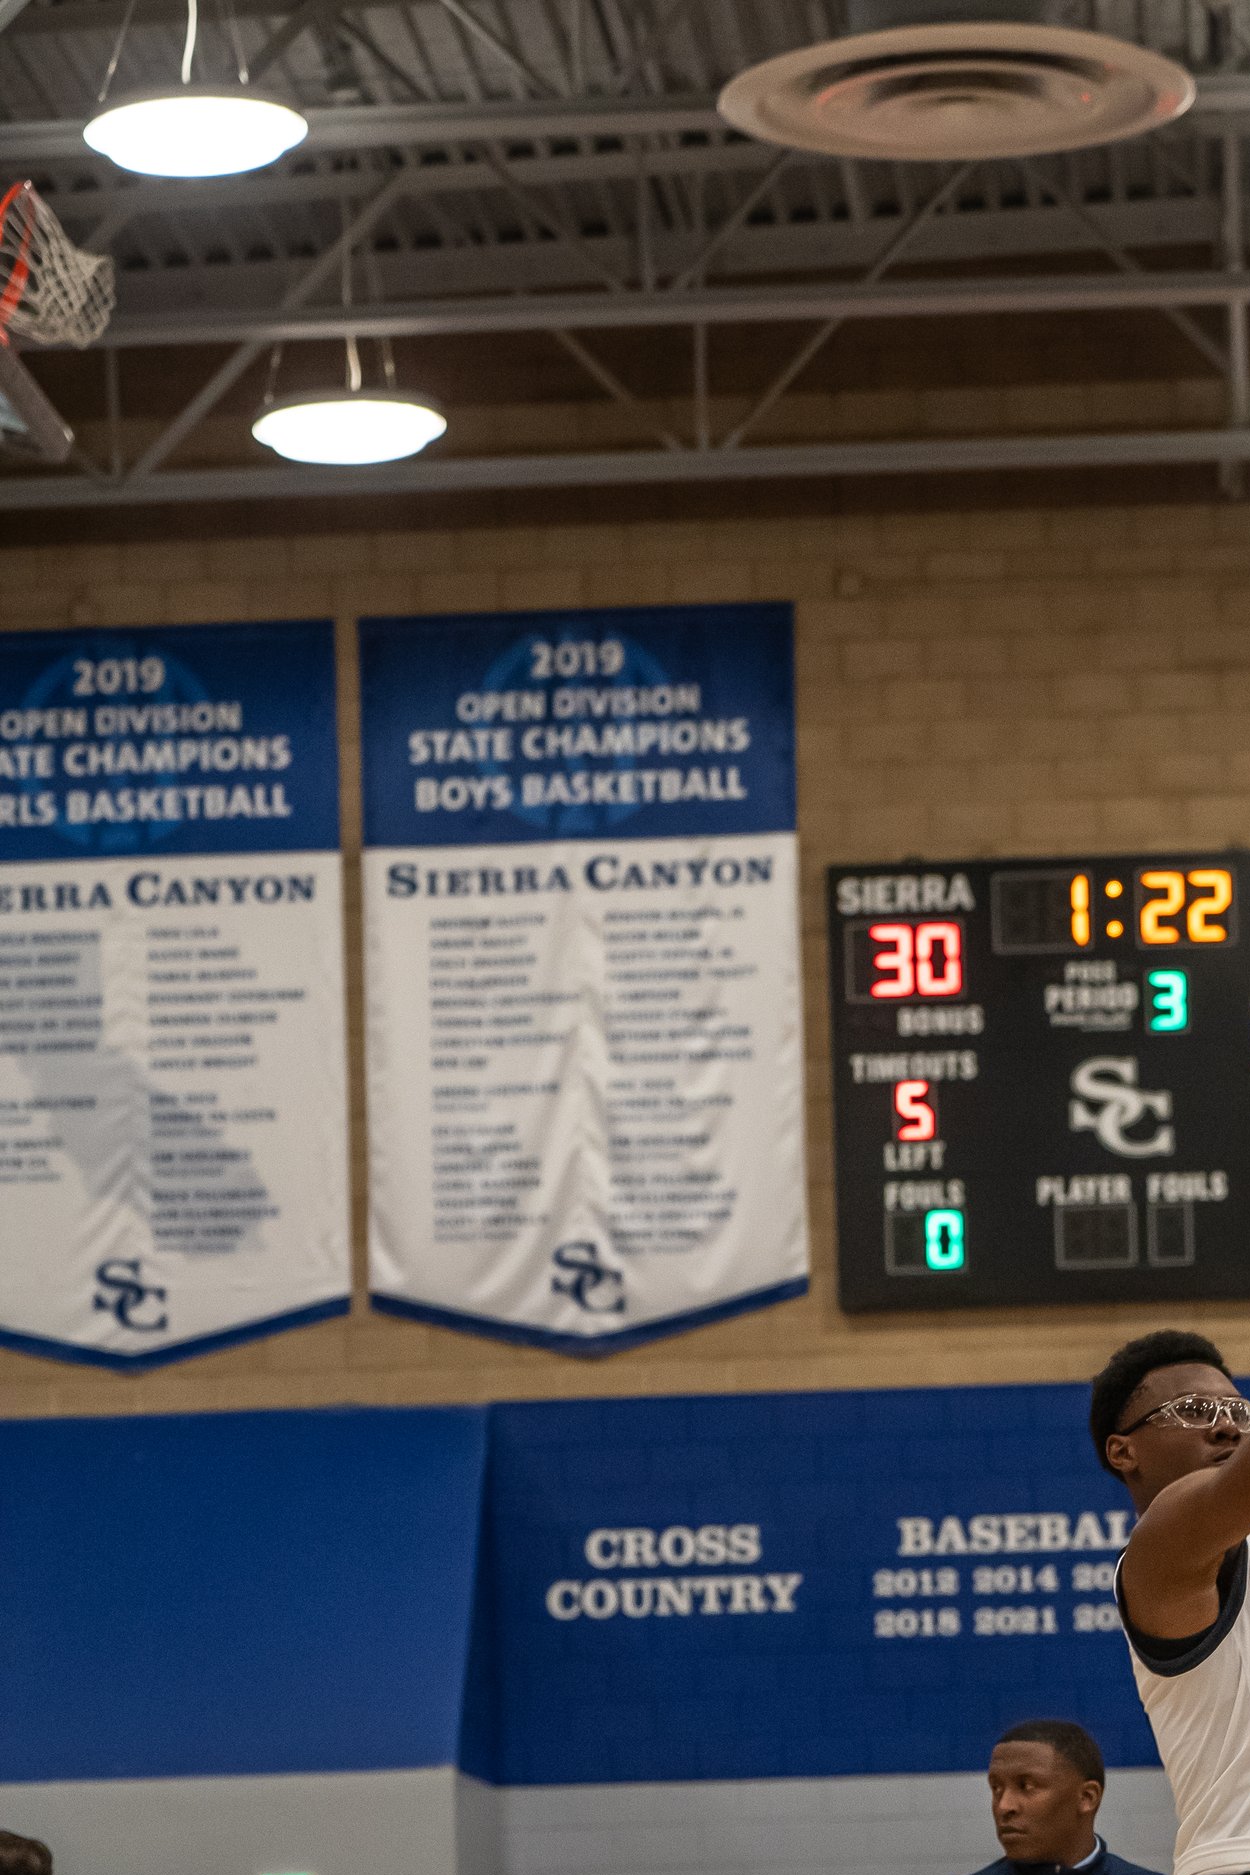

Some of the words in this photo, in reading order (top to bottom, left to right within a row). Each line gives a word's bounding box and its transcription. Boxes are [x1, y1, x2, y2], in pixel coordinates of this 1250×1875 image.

[73, 657, 166, 696] 2019
[534, 641, 625, 679] 2019
[0, 706, 88, 740] OPEN
[95, 701, 243, 735] DIVISION
[455, 692, 546, 724] OPEN
[553, 684, 699, 717] DIVISION
[63, 735, 292, 777] CHAMPIONS
[409, 728, 513, 765] STATE
[522, 718, 750, 760] CHAMPIONS
[66, 785, 291, 824] BASKETBALL
[415, 776, 512, 812] BOYS
[521, 768, 746, 807] BASKETBALL
[127, 871, 316, 907] CANYON
[387, 862, 574, 899] SIERRA
[583, 855, 775, 892] CANYON
[837, 874, 976, 915] SIERRA
[1071, 869, 1233, 947] 1:22
[868, 920, 962, 998] 30
[1044, 982, 1139, 1013] PERIOD
[1148, 969, 1188, 1032] 3
[897, 1004, 984, 1037] BONUS
[850, 1051, 978, 1083] TIMEOUTS
[894, 1079, 936, 1141] 5
[883, 1139, 946, 1171] LEFT
[883, 1179, 966, 1212] FOULS
[1036, 1173, 1132, 1206] PLAYER
[1146, 1169, 1228, 1203] FOULS
[925, 1209, 964, 1271] 0
[585, 1524, 762, 1569] CROSS
[545, 1572, 803, 1621] COUNTRY
[973, 1563, 1060, 1594] 2014
